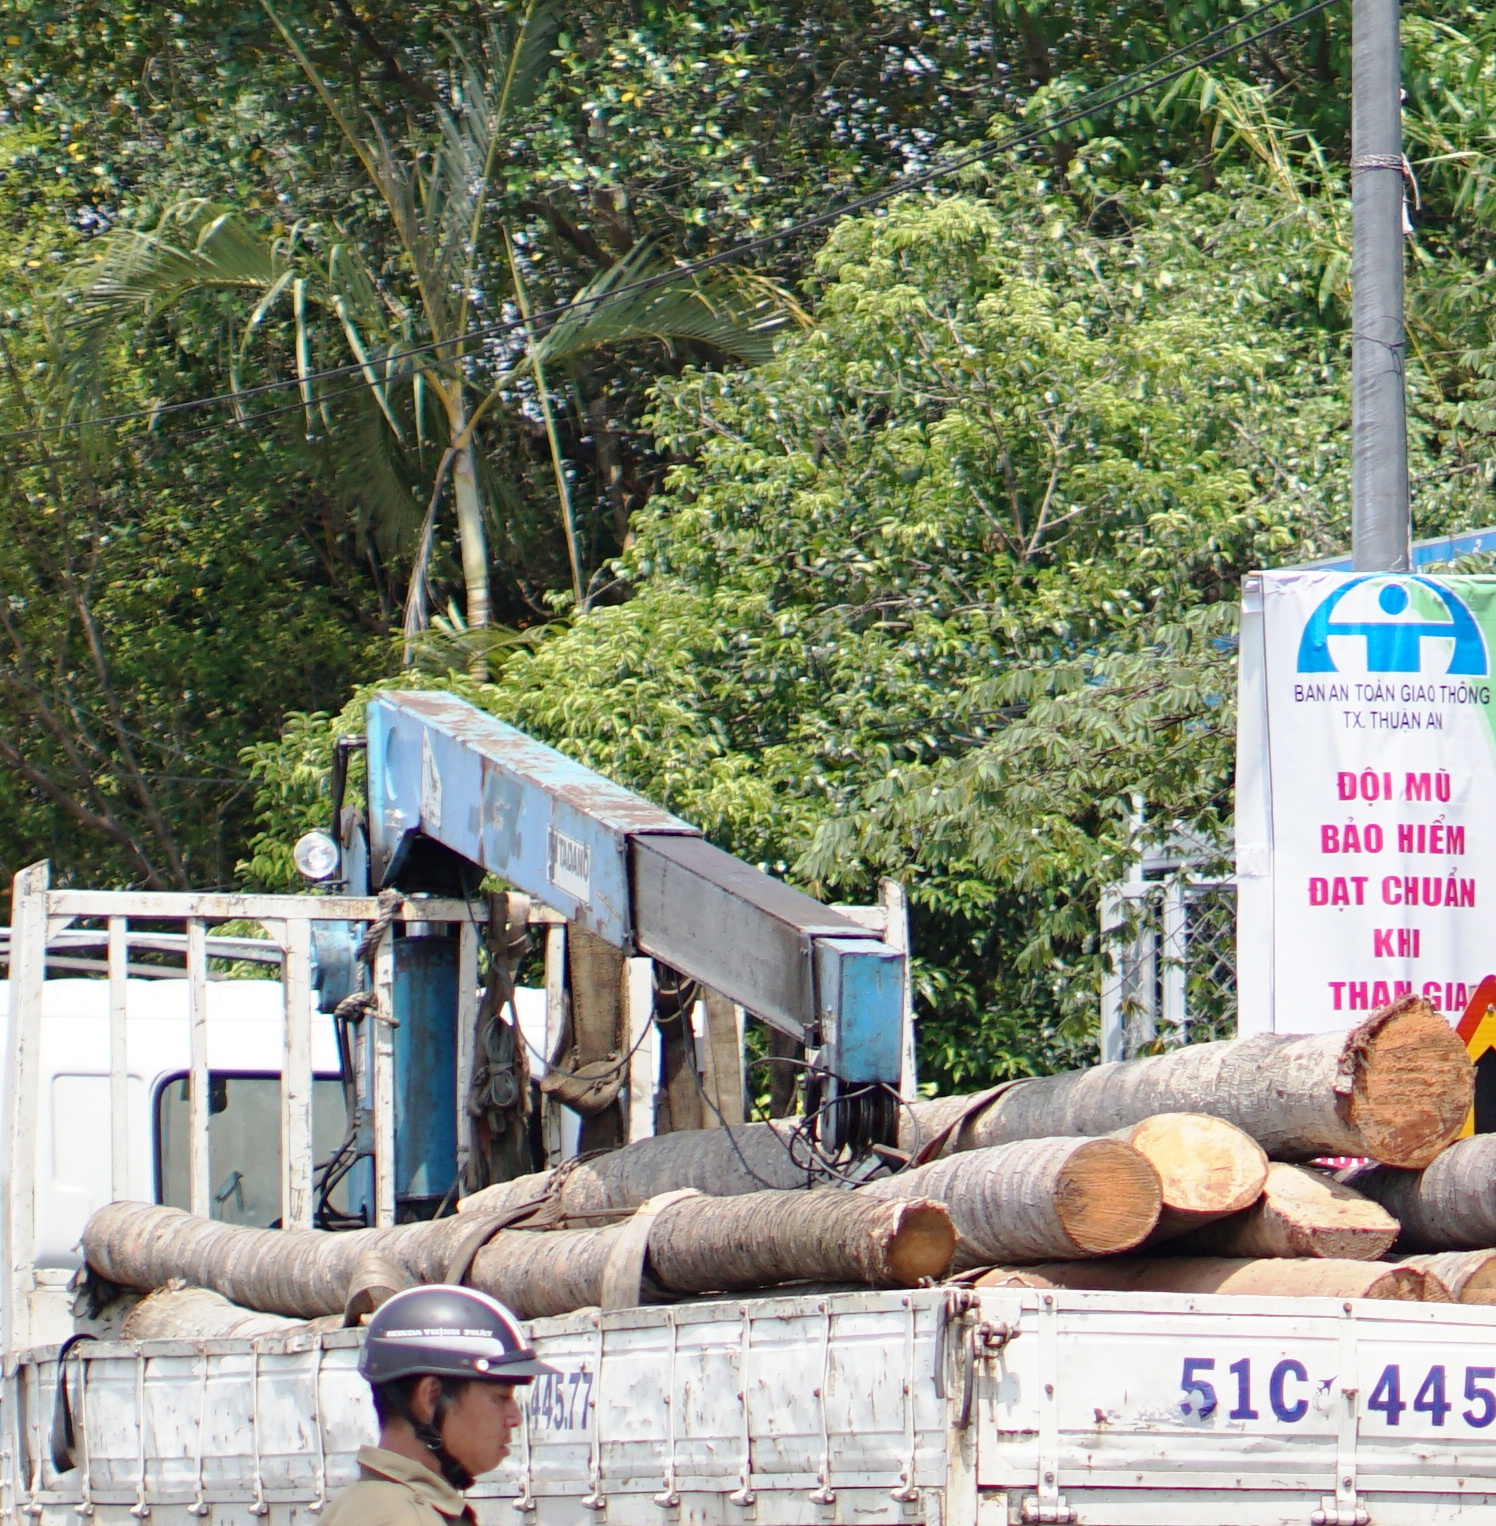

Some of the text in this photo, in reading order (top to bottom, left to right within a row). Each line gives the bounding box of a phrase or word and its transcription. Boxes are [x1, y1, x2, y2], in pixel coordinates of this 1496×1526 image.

[1294, 679, 1491, 704] BAN AN TOÀN GIAO THÔNG
[1343, 708, 1443, 733] TX. THUẬN AN
[1336, 766, 1451, 807] ĐỘI MŨ
[1321, 813, 1465, 855] BẢO HIỂM
[1307, 866, 1475, 912] ĐẠT CHUẨN
[1373, 928, 1420, 958] KHI
[1422, 981, 1468, 1012] GIA
[1179, 1357, 1310, 1424] 51C
